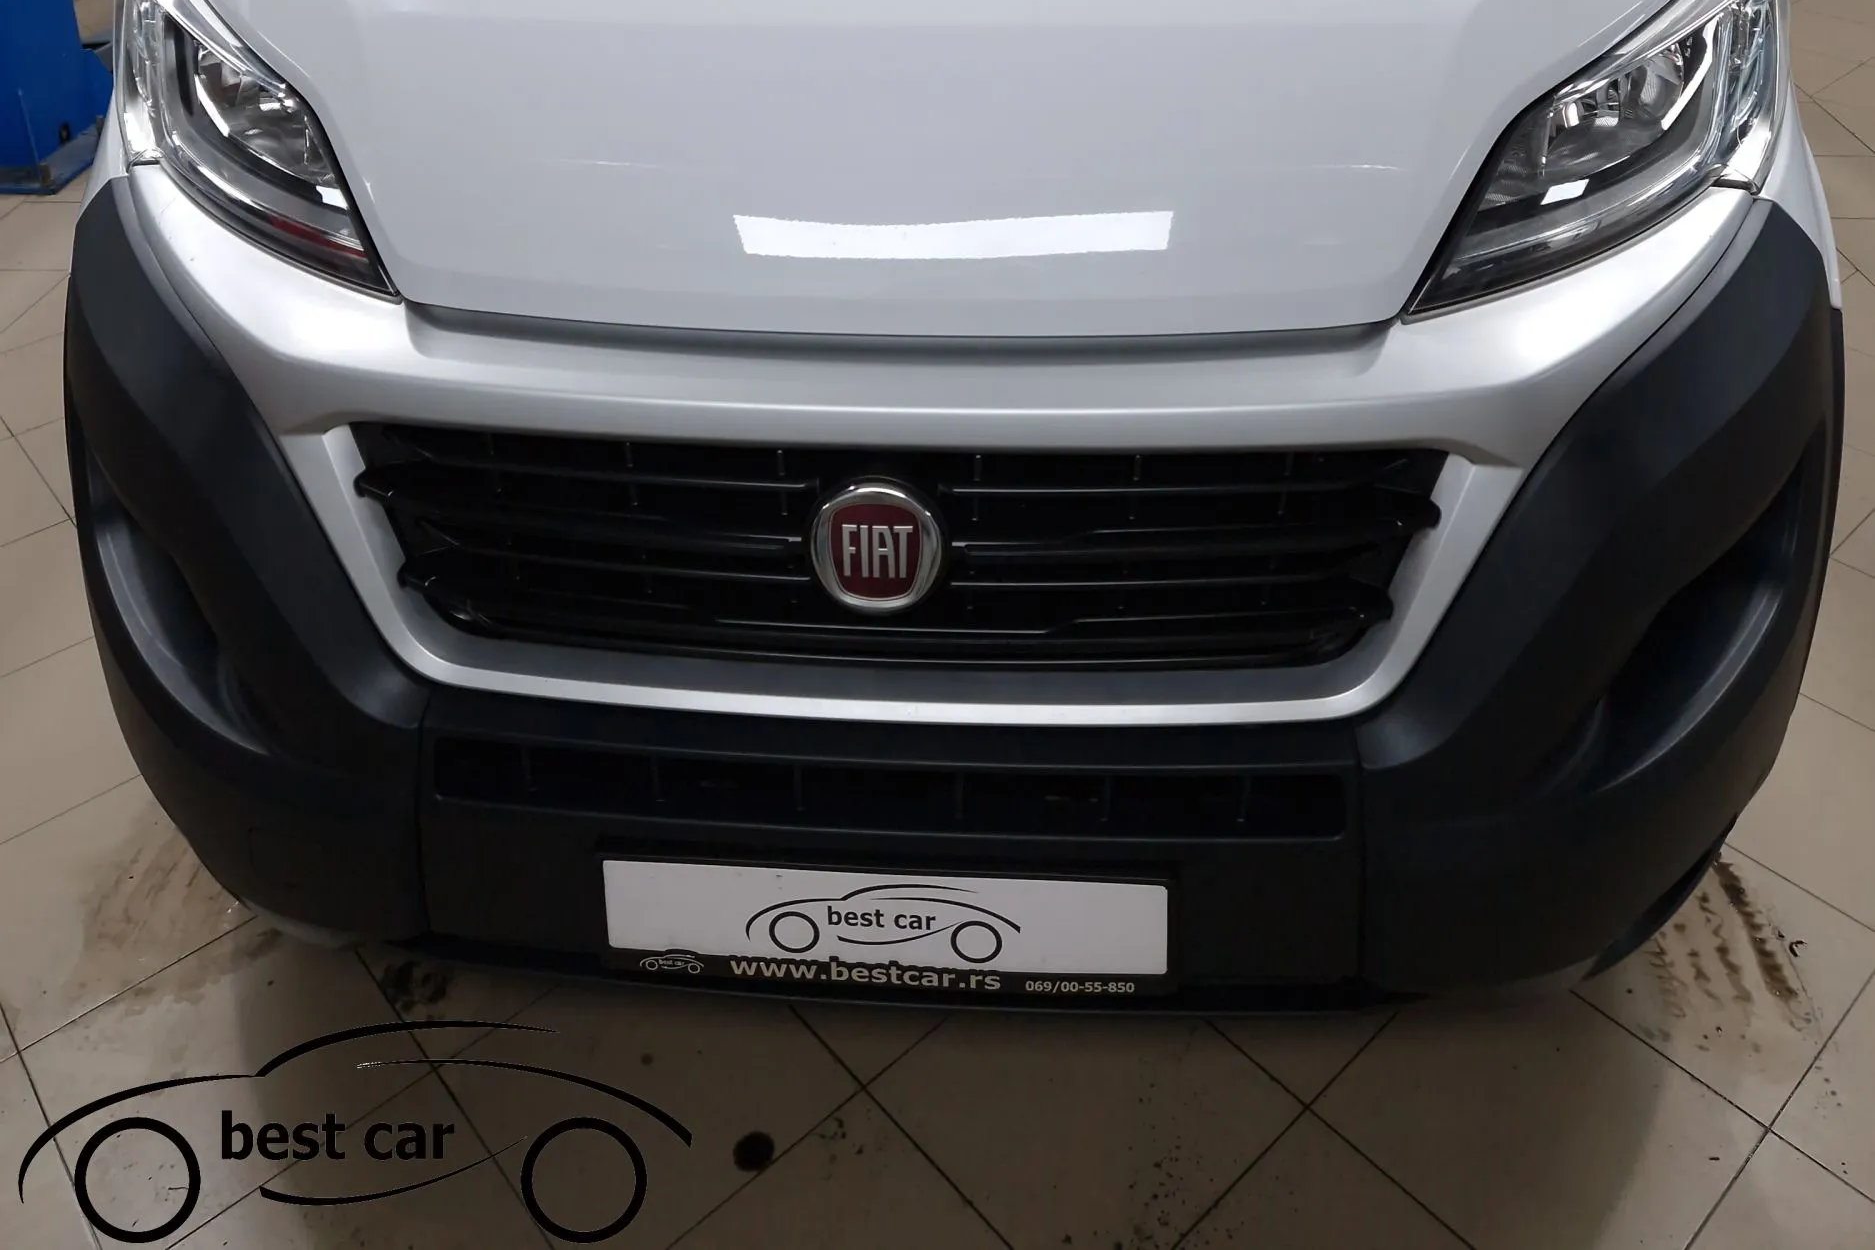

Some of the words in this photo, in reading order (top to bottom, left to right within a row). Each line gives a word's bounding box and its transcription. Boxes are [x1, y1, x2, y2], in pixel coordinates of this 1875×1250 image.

[841, 524, 914, 578] FIAT
[827, 905, 885, 928] best
[893, 913, 936, 930] car
[730, 958, 1001, 990] www.bestcar.rs
[1024, 979, 1136, 994] 069/00-55-850
